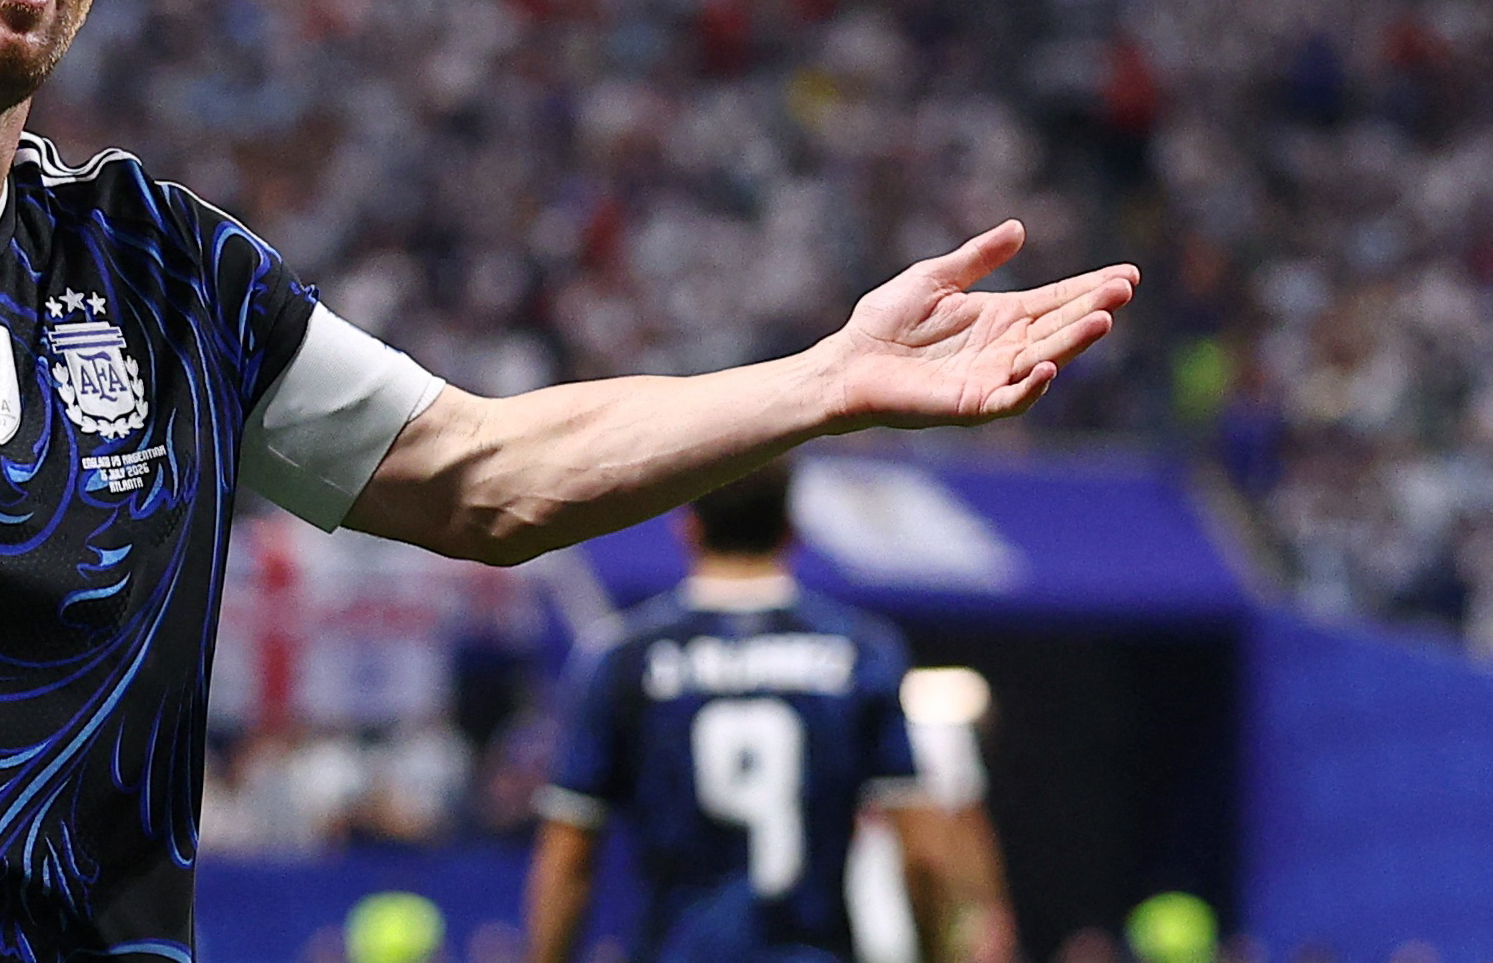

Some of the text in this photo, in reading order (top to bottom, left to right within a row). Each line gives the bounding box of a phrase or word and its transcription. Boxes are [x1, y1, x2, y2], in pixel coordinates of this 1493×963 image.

[76, 351, 127, 402] AFA
[122, 445, 167, 465] ARGENTINA
[126, 463, 150, 477] 2026
[109, 477, 144, 493] ATLANTA
[691, 697, 806, 900] 9
